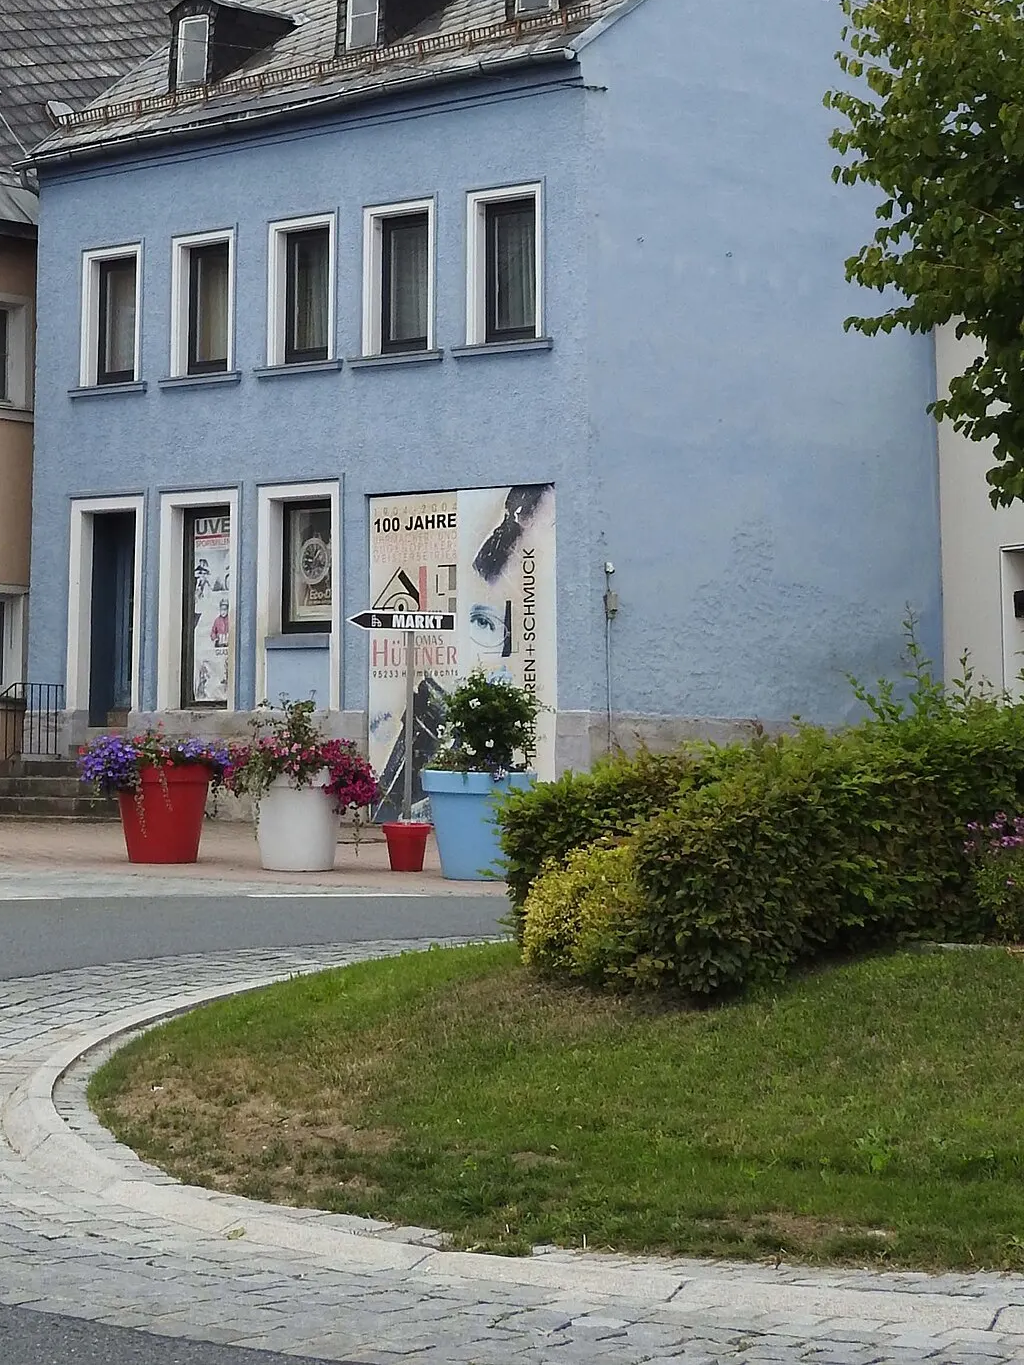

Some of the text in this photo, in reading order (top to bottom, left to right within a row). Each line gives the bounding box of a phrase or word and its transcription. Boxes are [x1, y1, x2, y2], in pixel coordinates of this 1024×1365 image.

[373, 513, 457, 533] 100 JAHRE
[522, 548, 536, 641] SCHMUCK
[392, 614, 443, 628] MARKT
[401, 631, 444, 646] TOMAS
[525, 644, 536, 656] +
[373, 668, 458, 678] 95233 Hmbrechts
